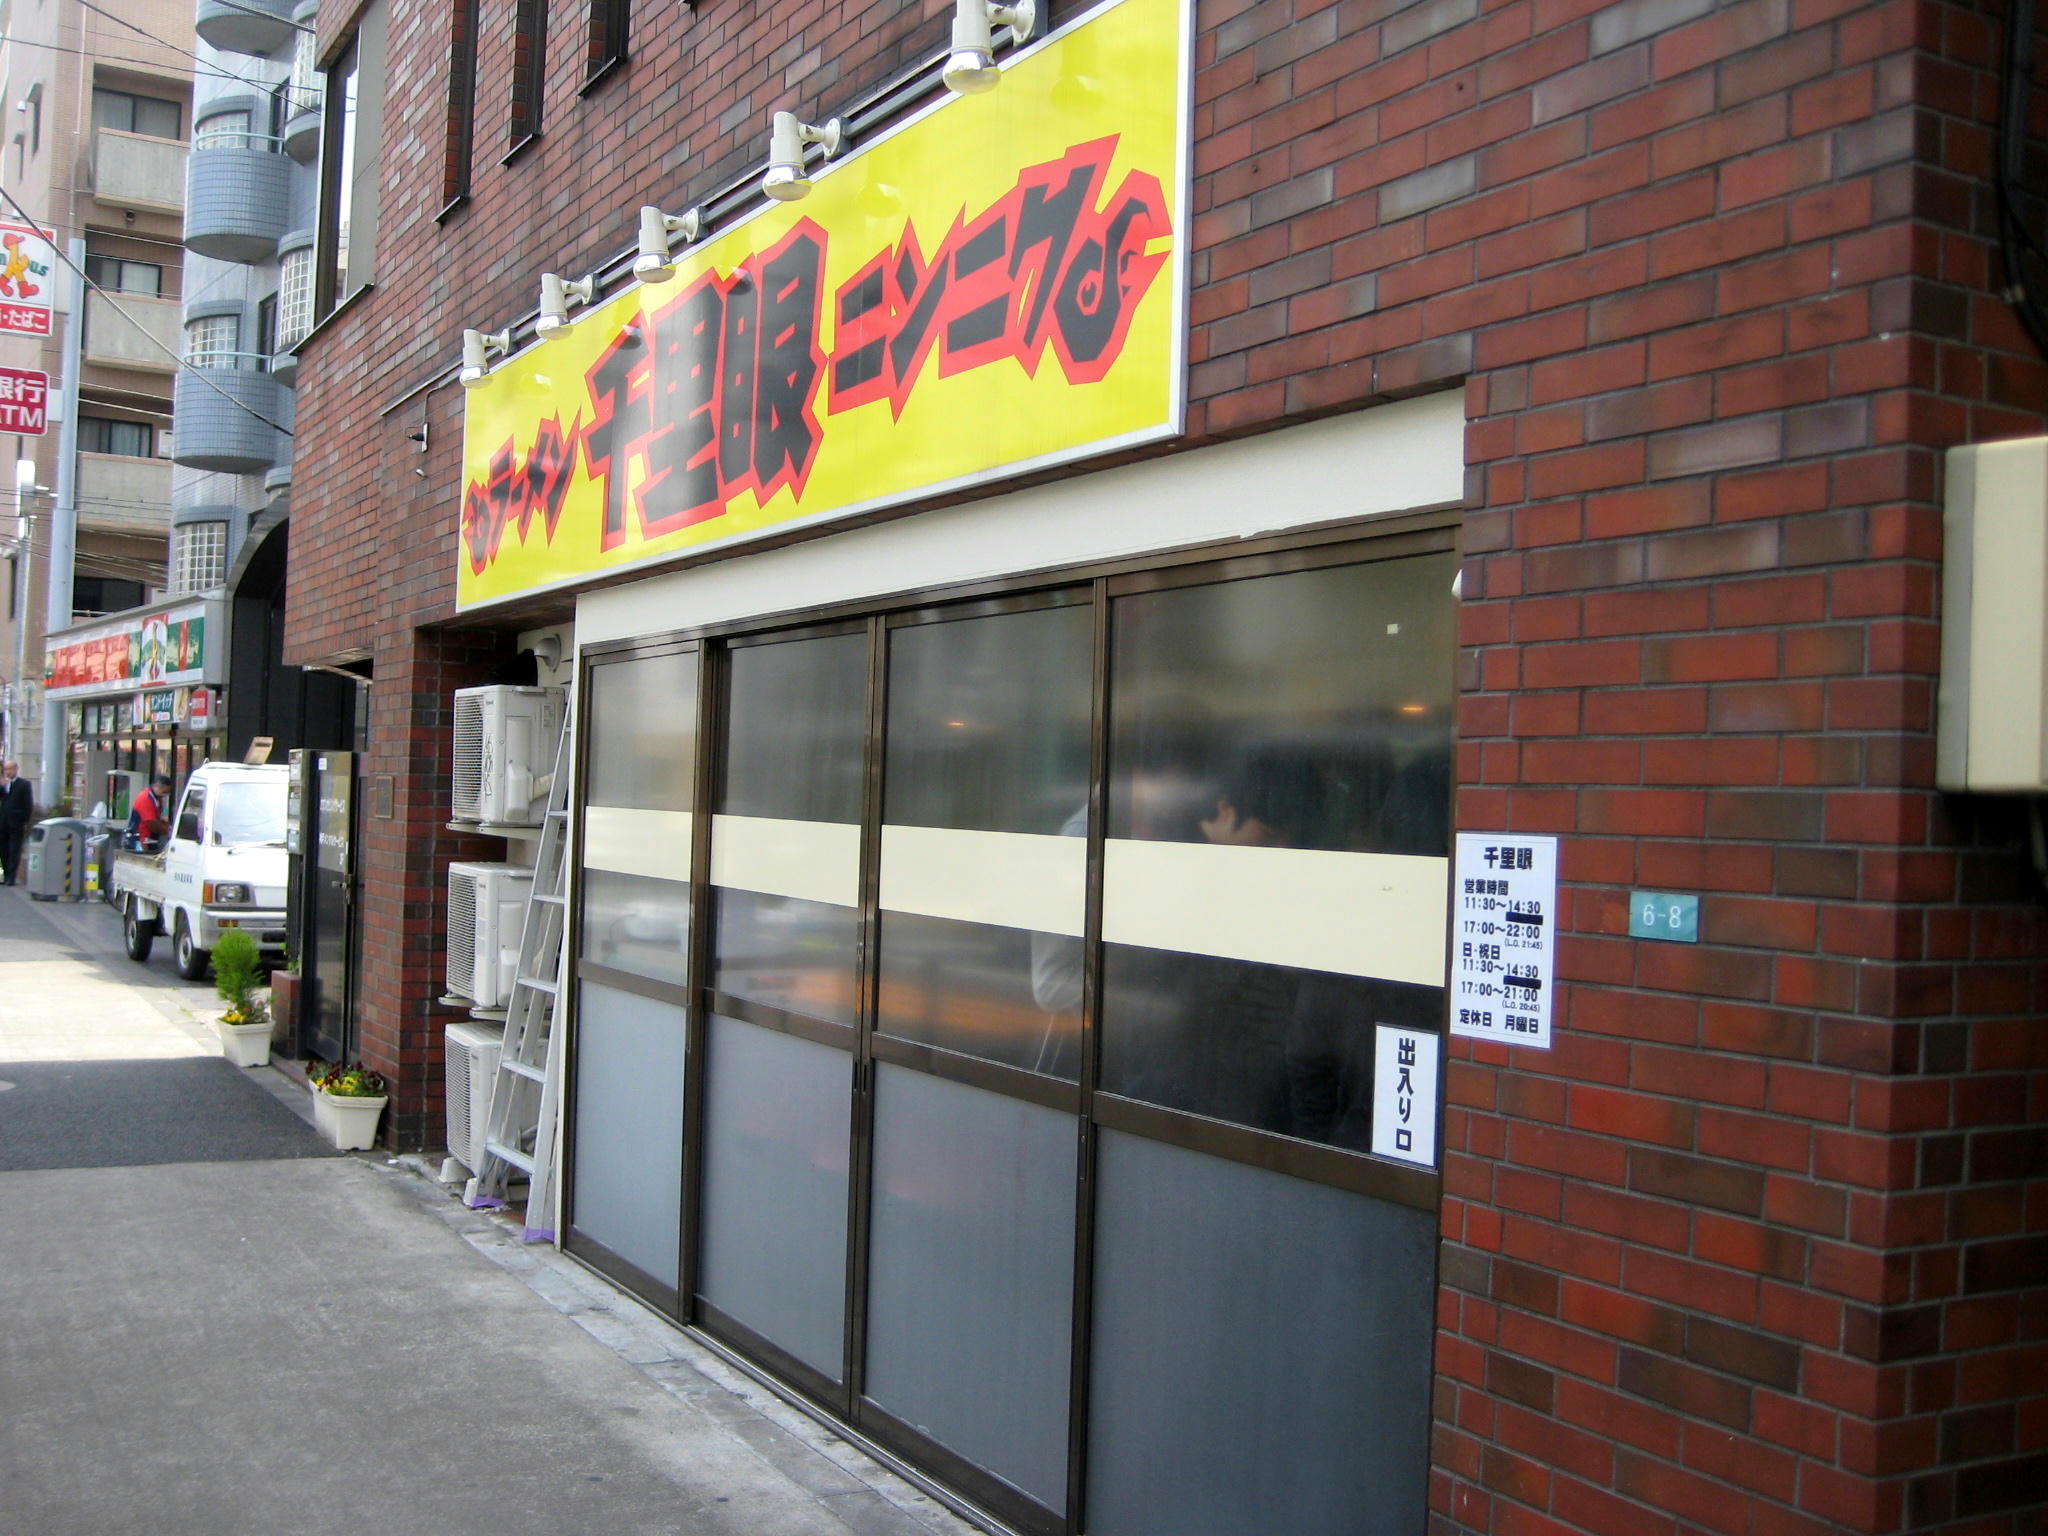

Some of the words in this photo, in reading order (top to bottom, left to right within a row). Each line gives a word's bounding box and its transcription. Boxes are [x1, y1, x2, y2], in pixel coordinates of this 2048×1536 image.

[0, 308, 47, 330] ・たばこ
[581, 216, 828, 550] 千里眼
[0, 403, 43, 428] TM
[1483, 846, 1533, 871] 千里眼
[1464, 877, 1509, 896] 営業時間
[1643, 903, 1681, 928] 6-8
[1459, 1008, 1492, 1027] 定休日
[1504, 1014, 1539, 1034] 月曜日
[1395, 1037, 1416, 1152] 出入り口
